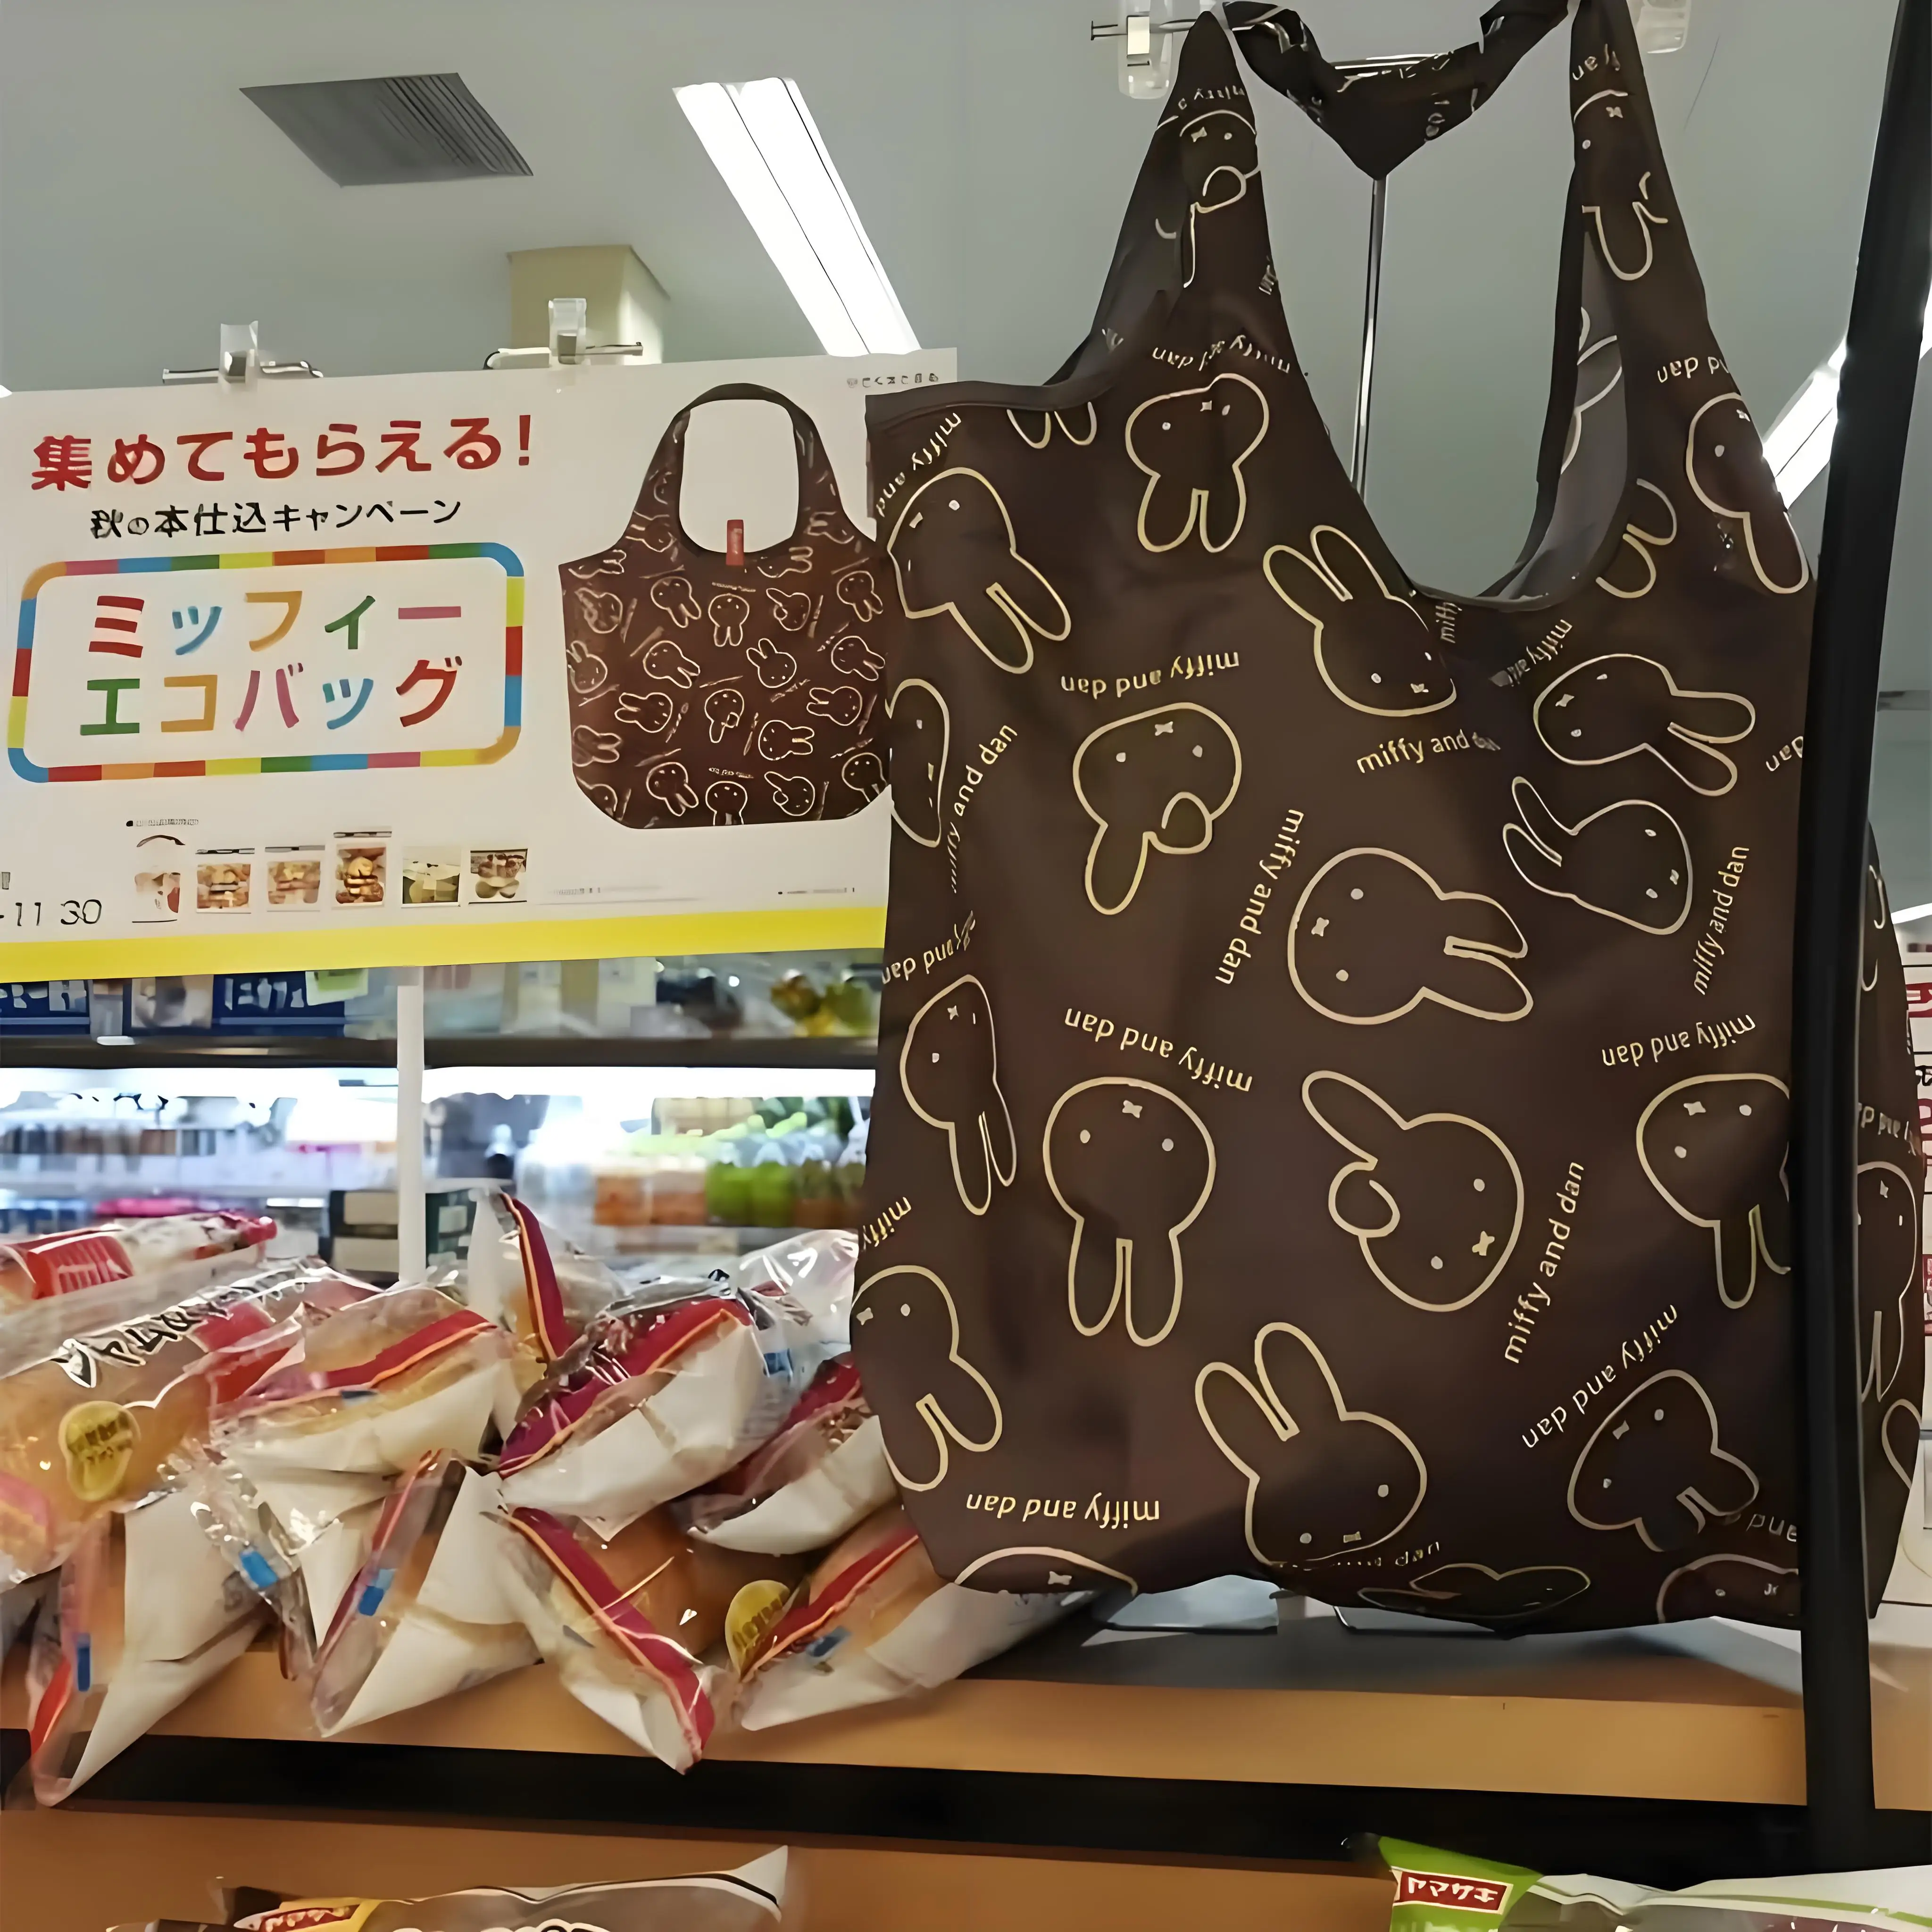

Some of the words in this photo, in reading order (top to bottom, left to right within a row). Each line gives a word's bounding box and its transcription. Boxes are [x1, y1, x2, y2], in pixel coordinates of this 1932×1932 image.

[1657, 357, 1699, 383] dan
[89, 591, 461, 658] ミッフィー
[1117, 669, 1162, 698] and
[1170, 651, 1239, 679] miffy
[80, 657, 462, 736] エコバッグ
[1061, 675, 1107, 700] dan
[954, 764, 983, 816] and
[979, 725, 1018, 765] dan
[1357, 738, 1424, 774] miffy
[1431, 729, 1470, 753] and
[1260, 809, 1304, 879] miffy
[1718, 847, 1749, 887] dan
[1240, 883, 1272, 935] and
[1709, 889, 1733, 933] and
[882, 957, 916, 984] dan
[923, 939, 954, 974] and
[1216, 938, 1252, 984] dan
[1693, 933, 1724, 995] miffy
[1065, 1008, 1114, 1043] dan
[1120, 1027, 1174, 1058] and
[1697, 1014, 1756, 1049] miffy
[1179, 1047, 1253, 1092] miffy
[1602, 1041, 1644, 1067] dan
[1651, 1037, 1690, 1062] and
[1504, 1282, 1551, 1364] miffy
[1540, 1218, 1571, 1278] and
[1556, 1161, 1584, 1216] dan
[1622, 1304, 1677, 1370] miffy
[1574, 1365, 1617, 1414] and
[1522, 1405, 1567, 1448] dan
[966, 1493, 1016, 1519] dan
[1023, 1499, 1077, 1523] and
[1084, 1492, 1160, 1529] miffy
